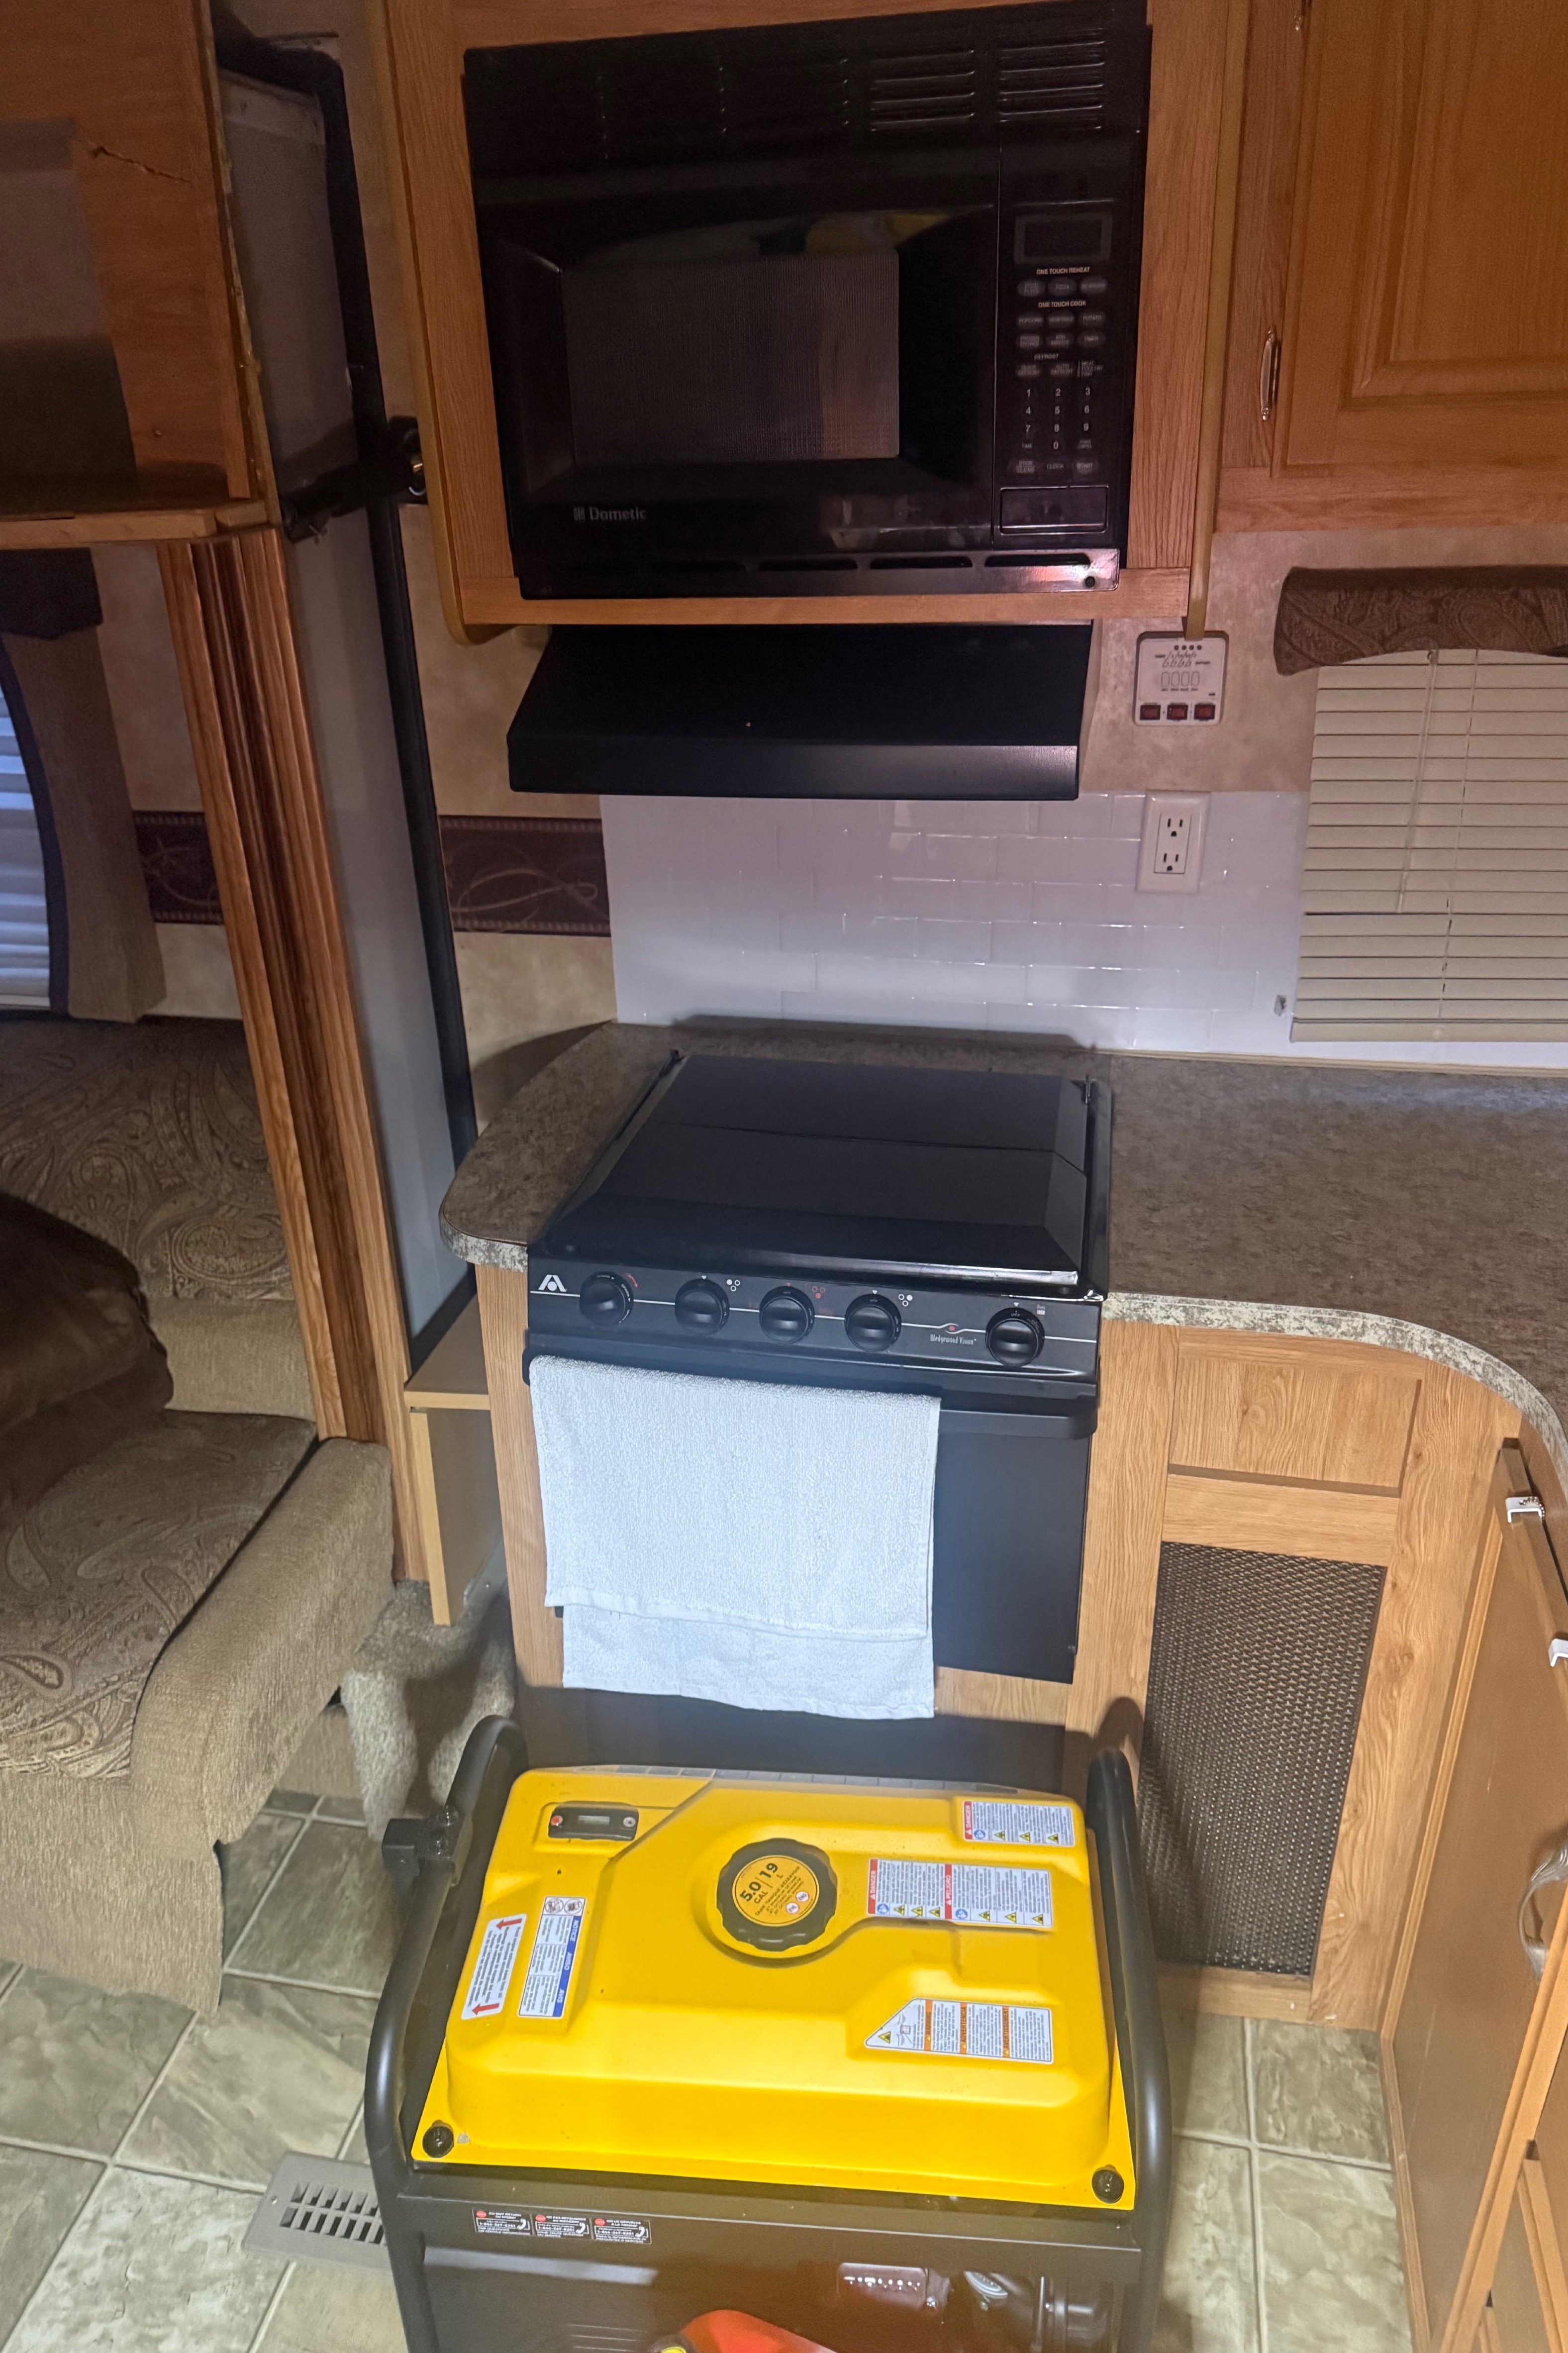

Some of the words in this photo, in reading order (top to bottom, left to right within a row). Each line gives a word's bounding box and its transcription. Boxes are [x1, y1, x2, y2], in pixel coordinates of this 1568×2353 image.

[1027, 389, 1031, 397] 1
[1055, 406, 1060, 414] 5
[1084, 405, 1089, 413] 6
[1083, 422, 1088, 431] 9
[589, 506, 647, 520] Dometic
[930, 1334, 958, 1344] Wedgewood
[759, 1863, 778, 1878] 19
[739, 1881, 761, 1902] 5.0
[570, 1920, 579, 1942] NOTICE
[564, 1951, 572, 1970] AVISO
